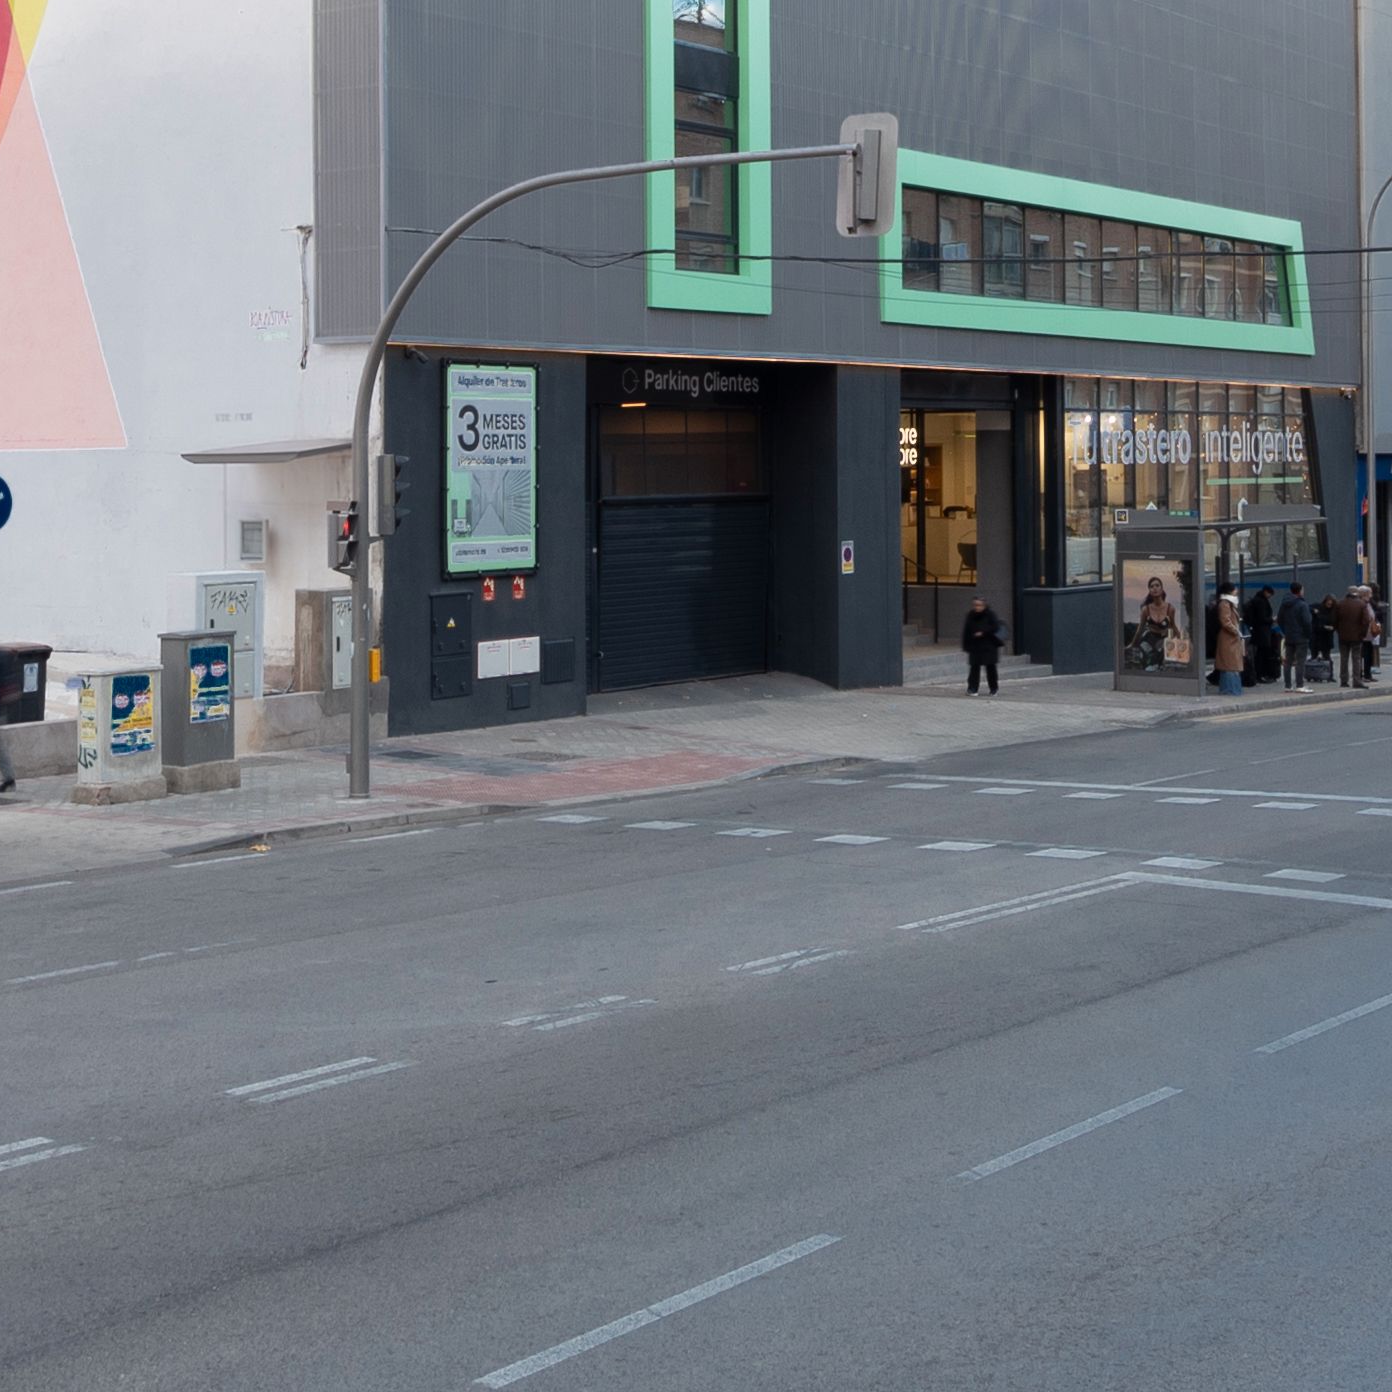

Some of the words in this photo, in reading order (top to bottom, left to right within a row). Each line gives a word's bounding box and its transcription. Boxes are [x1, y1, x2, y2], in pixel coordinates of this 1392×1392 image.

[644, 368, 700, 398] Parking
[703, 371, 760, 393] Clientes
[457, 404, 480, 452] 3
[482, 413, 526, 431] MESES
[482, 433, 527, 450] GRATIS
[1068, 420, 1097, 465] Tu
[1100, 421, 1192, 466] trastero
[1204, 420, 1305, 476] inteligente
